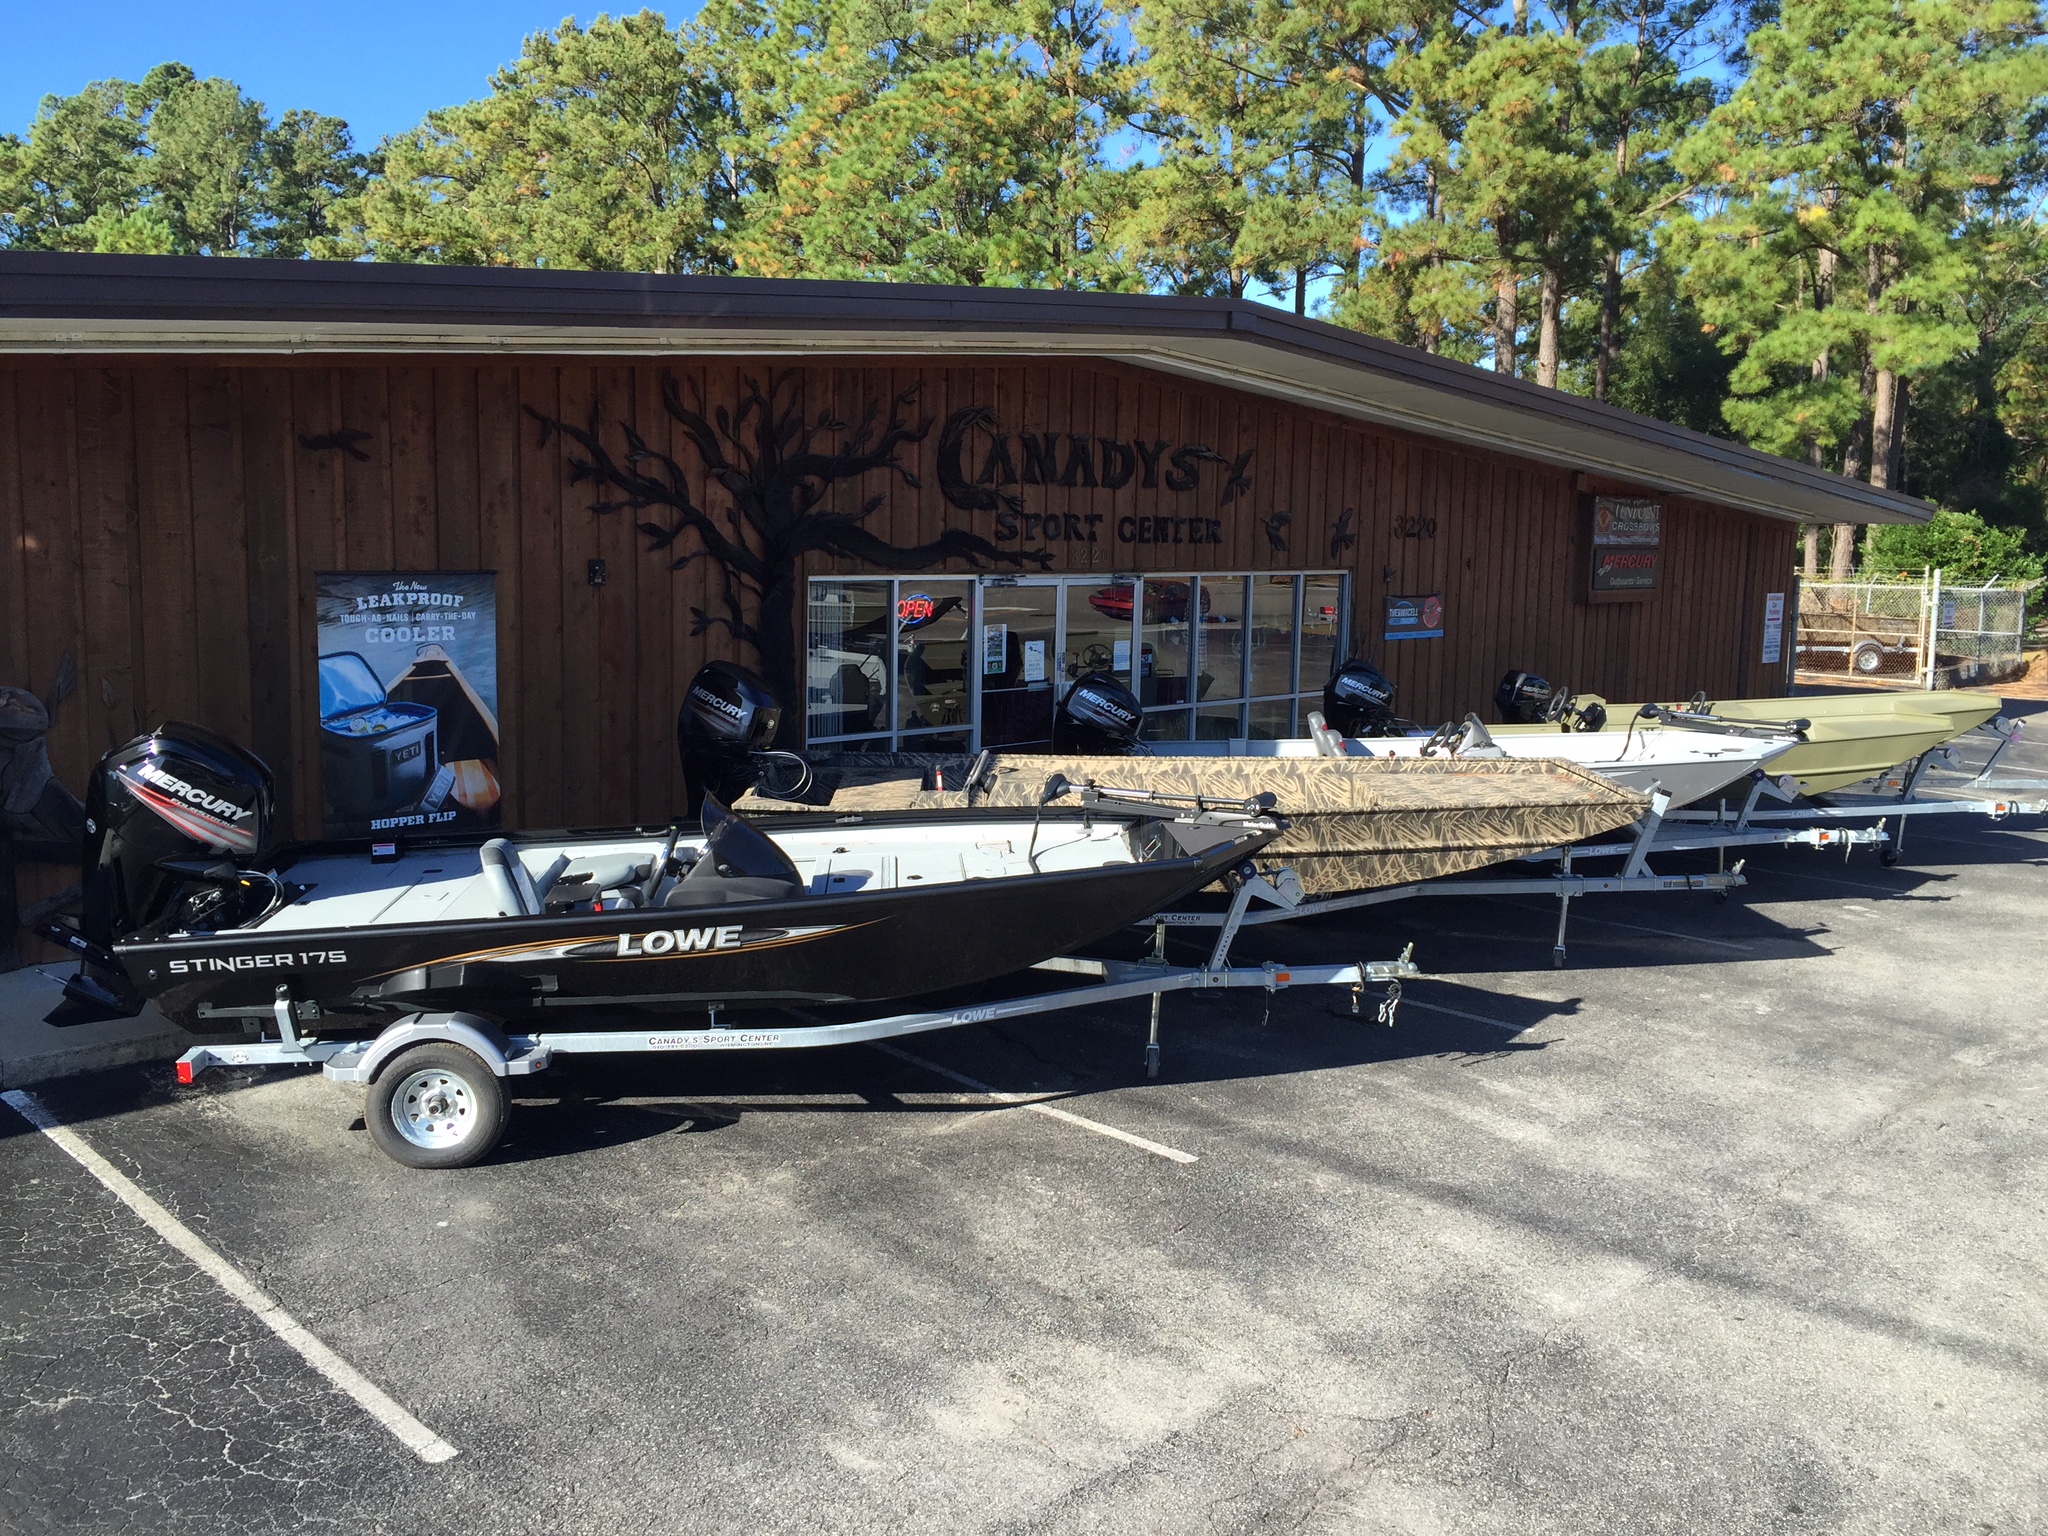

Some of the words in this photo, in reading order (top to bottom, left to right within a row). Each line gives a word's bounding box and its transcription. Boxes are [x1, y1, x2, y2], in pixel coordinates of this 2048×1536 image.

[995, 511, 1104, 542] SPORT
[1117, 515, 1223, 544] CENTER
[1393, 515, 1438, 540] 3220
[1611, 521, 1660, 533] CROSSBOWS
[1070, 546, 1110, 563] 3220
[1602, 554, 1659, 569] MERCURY
[392, 581, 410, 592] The
[411, 580, 428, 591] New
[356, 592, 464, 610] LEAKPROOF
[897, 599, 934, 618] OPEN
[364, 625, 456, 643] COOLER
[1340, 676, 1387, 700] MERCURY
[1521, 685, 1550, 695] MERCURY
[692, 685, 748, 719] MERCURY
[1078, 688, 1136, 722] MERCURY
[394, 744, 420, 761] YETI
[136, 763, 254, 822] MERCURY
[427, 775, 451, 804] YETI
[370, 814, 425, 830] HOPPER
[428, 810, 457, 823] FLIP
[1791, 810, 1817, 818] LOWE
[1588, 846, 1618, 855] LOWE
[1298, 902, 1328, 915] LOWE
[617, 925, 743, 957] LOWE
[169, 953, 295, 973] STINGER
[299, 950, 348, 965] 175
[952, 1007, 996, 1024] LOWE
[703, 1035, 737, 1044] SPORT
[740, 1034, 780, 1043] CENTER
